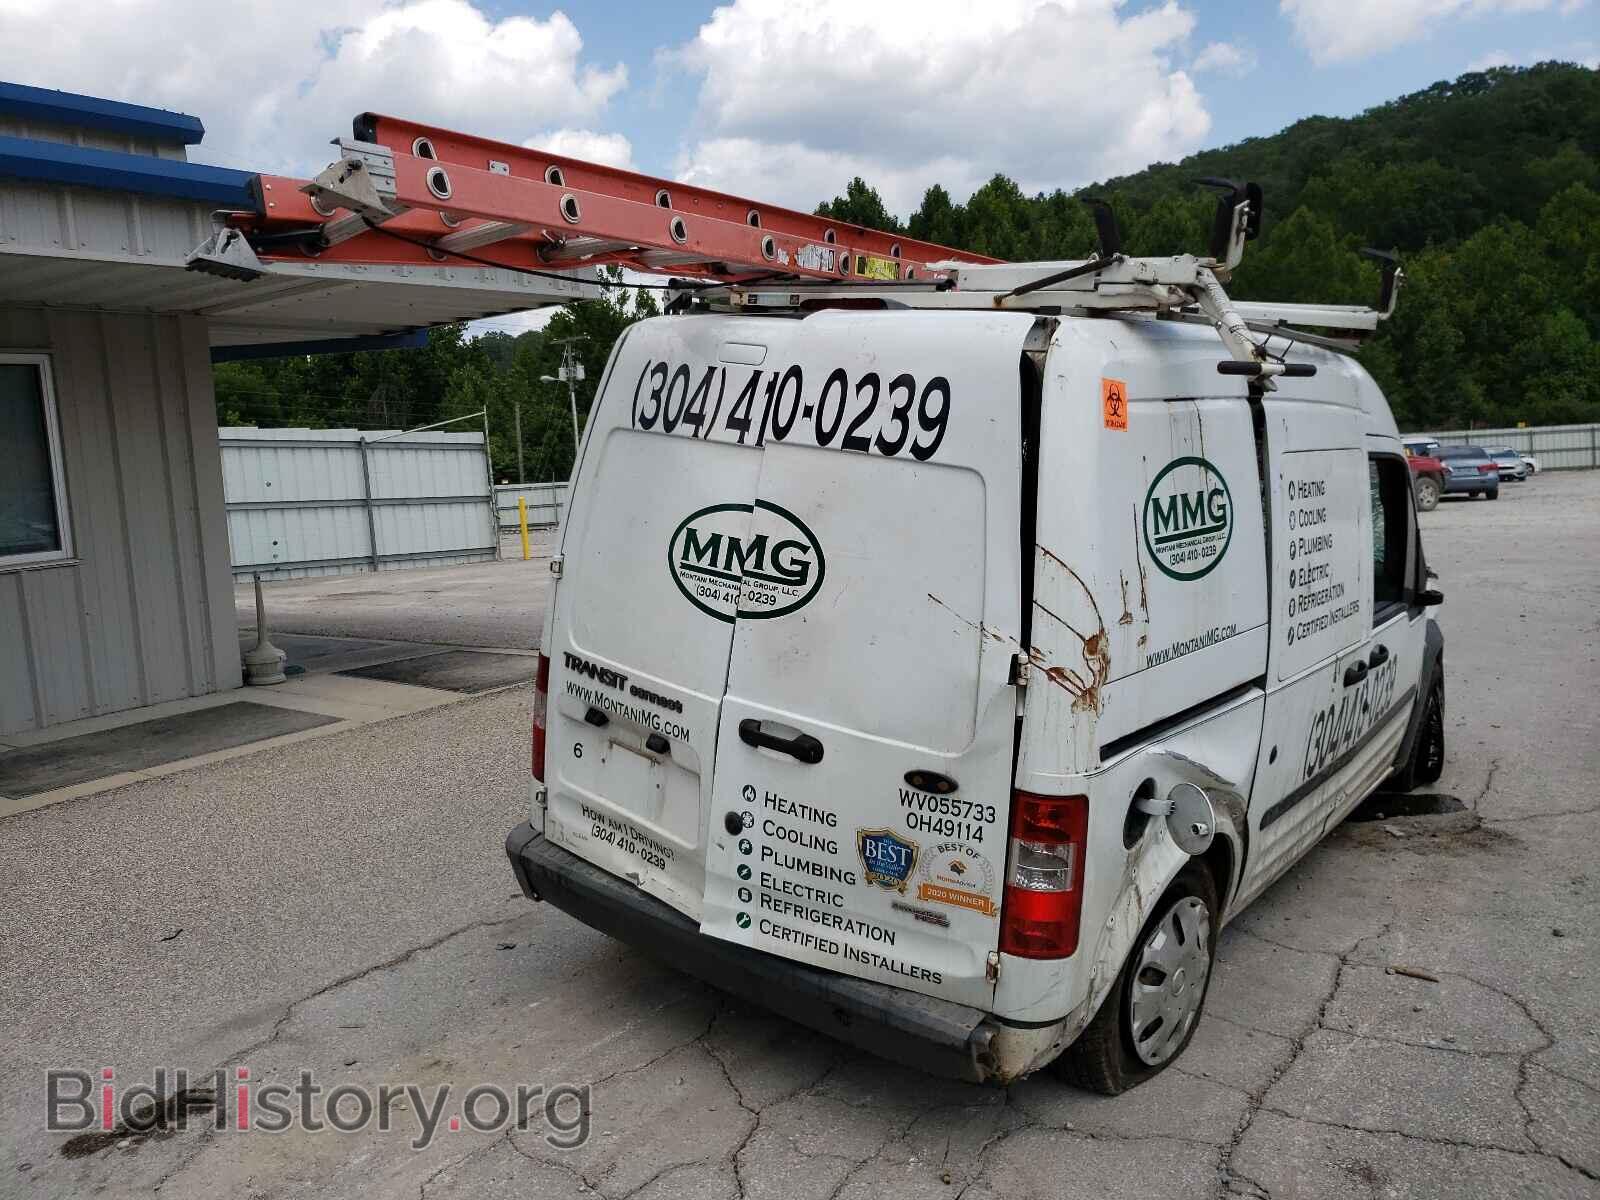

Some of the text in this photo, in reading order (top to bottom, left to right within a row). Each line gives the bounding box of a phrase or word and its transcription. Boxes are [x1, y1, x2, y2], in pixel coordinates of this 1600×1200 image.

[632, 359, 951, 461] (304) 410-0239
[1297, 480, 1326, 499] HEATING
[1151, 488, 1227, 534] MMG
[1298, 507, 1327, 527] COOLING
[681, 527, 811, 582] MMG
[1298, 533, 1333, 557] PLUMBING
[679, 571, 708, 584] MONTANI
[1298, 563, 1330, 587] ELECTRIC
[696, 585, 721, 601] (304)
[1297, 582, 1345, 614] REFRIGERATION
[1296, 614, 1329, 640] CERTIFIED
[563, 651, 629, 692] TRANSIT
[573, 742, 584, 758] 6
[581, 803, 605, 824] HOW
[764, 791, 838, 828] HEATING
[898, 787, 997, 824] WV055733
[762, 819, 838, 855] COOLING
[905, 812, 984, 843] OH49114
[591, 823, 666, 870] (304) 410-0239
[865, 838, 911, 866] BEST
[936, 843, 981, 860] BEST OF
[760, 845, 856, 885] PLUMBING
[760, 871, 844, 908] ELECTRIC
[927, 887, 985, 908] 2020 WINNER
[760, 893, 896, 946] REFRIGERATION
[759, 918, 942, 985] CERTIFIED INSTALLERS
